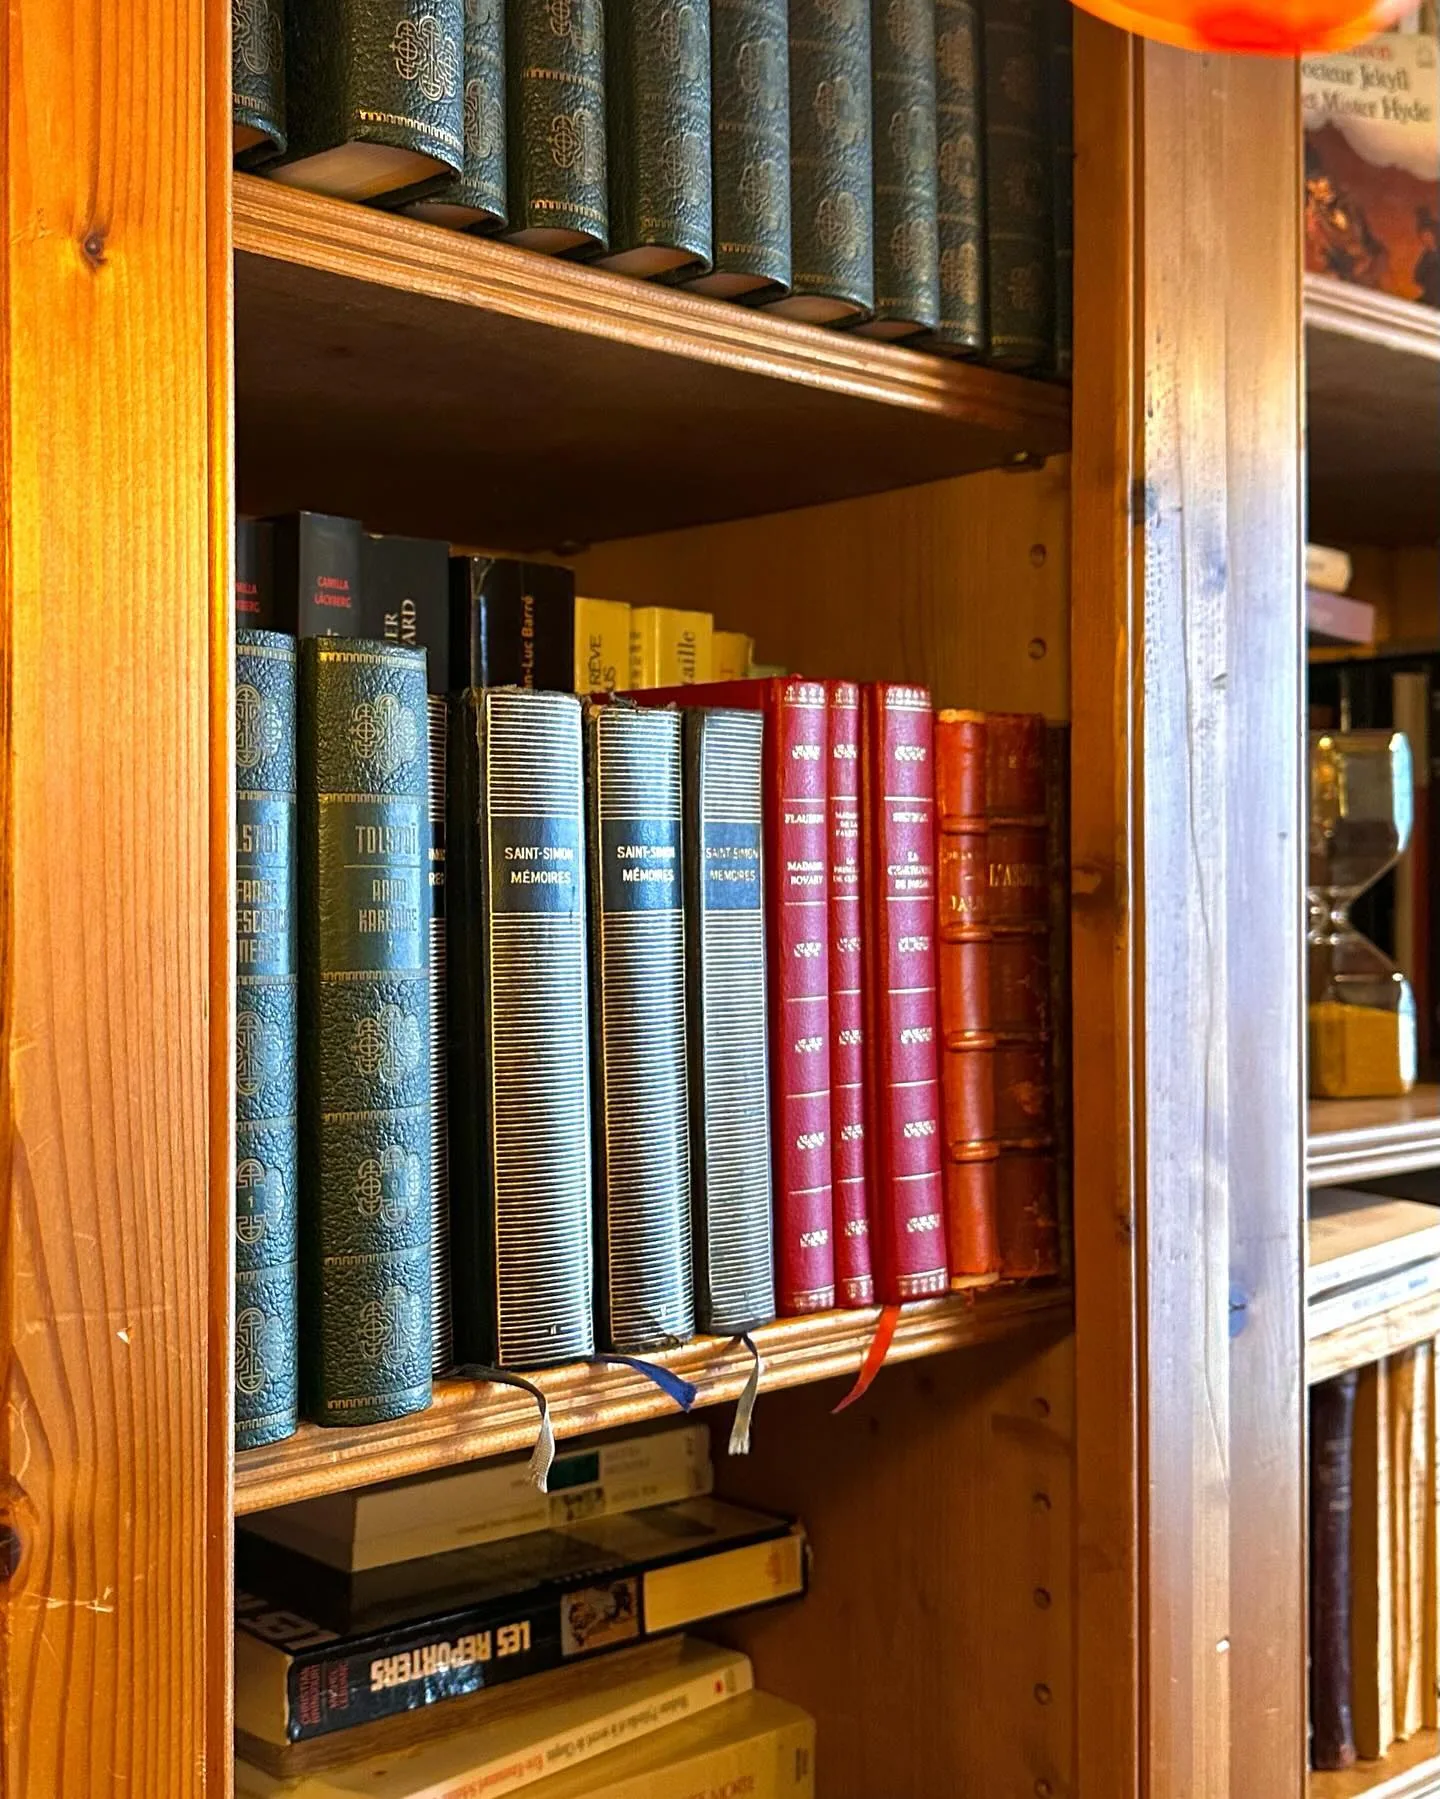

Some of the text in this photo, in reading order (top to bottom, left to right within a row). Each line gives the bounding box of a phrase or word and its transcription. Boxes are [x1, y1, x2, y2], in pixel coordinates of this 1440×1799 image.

[1382, 95, 1431, 124] Hyde
[317, 575, 350, 590] CAMILLA
[521, 595, 534, 637] Barré
[355, 822, 417, 854] TOLSTOÏ
[504, 846, 573, 860] SAINT-SIMON
[617, 846, 676, 860] SAINT-SIMON
[511, 868, 572, 884] MÉMOIRES
[622, 866, 675, 883] MÉMOIRES
[370, 1620, 531, 1692] LES REPORTERS
